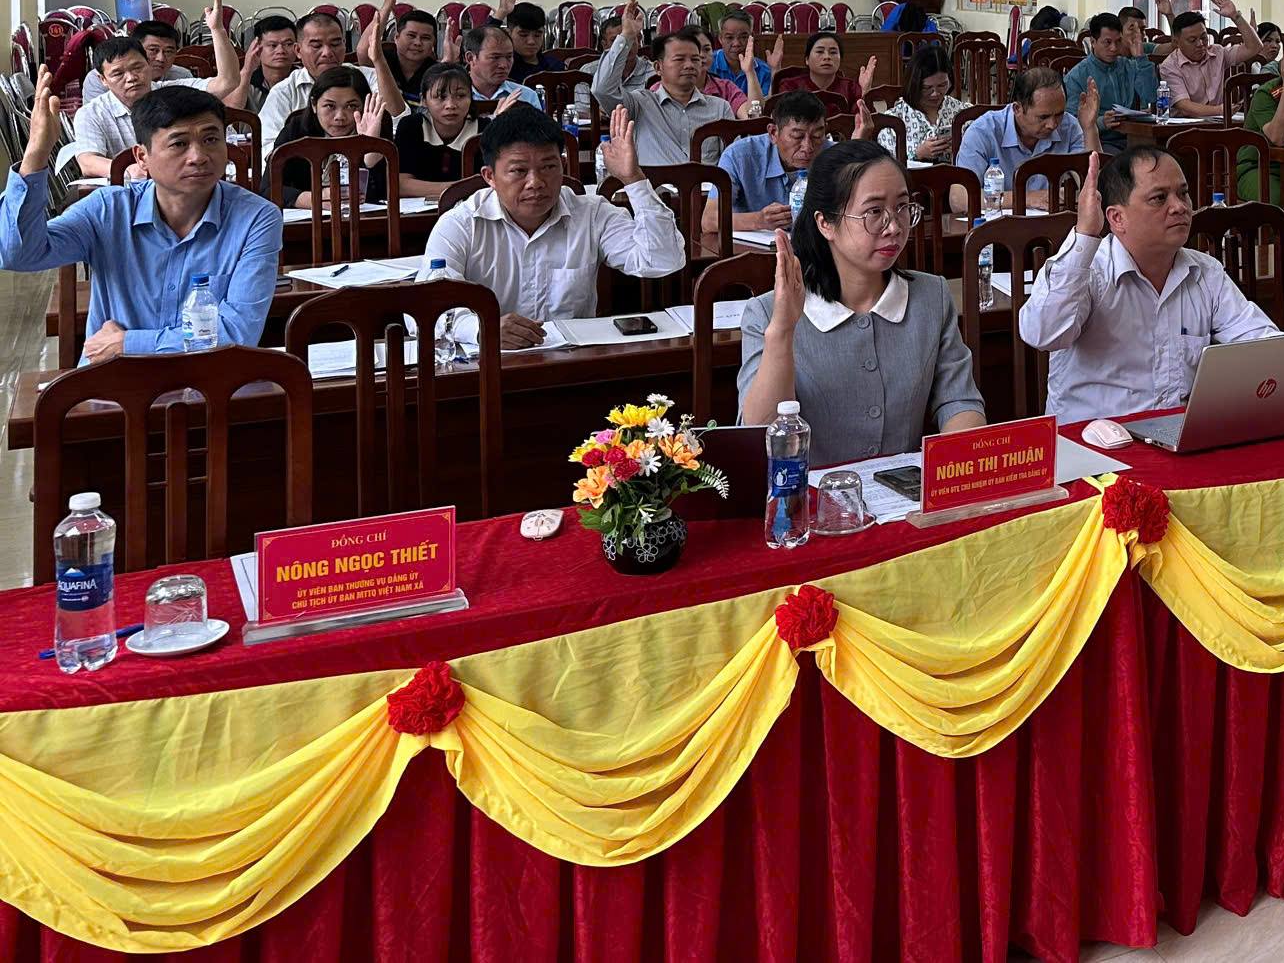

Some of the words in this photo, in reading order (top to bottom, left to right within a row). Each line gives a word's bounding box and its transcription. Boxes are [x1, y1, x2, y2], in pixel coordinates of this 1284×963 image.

[972, 437, 995, 450] ĐỒNG
[996, 435, 1011, 446] CHÍ
[936, 461, 974, 480] NÔNG
[977, 455, 998, 473] THỊ
[1002, 447, 1044, 466] THUẬN
[331, 532, 363, 548] ĐỒNG
[366, 530, 388, 544] CHÍ
[276, 560, 329, 583] NÔNG
[335, 552, 385, 573] NGỌC
[390, 539, 438, 565] THIẾT
[309, 584, 327, 596] VIÊN
[328, 583, 344, 593] BAN
[309, 596, 326, 608] TỊCH
[340, 592, 355, 601] BAN
[378, 585, 394, 596] VIỆT
[395, 583, 413, 593] NAM
